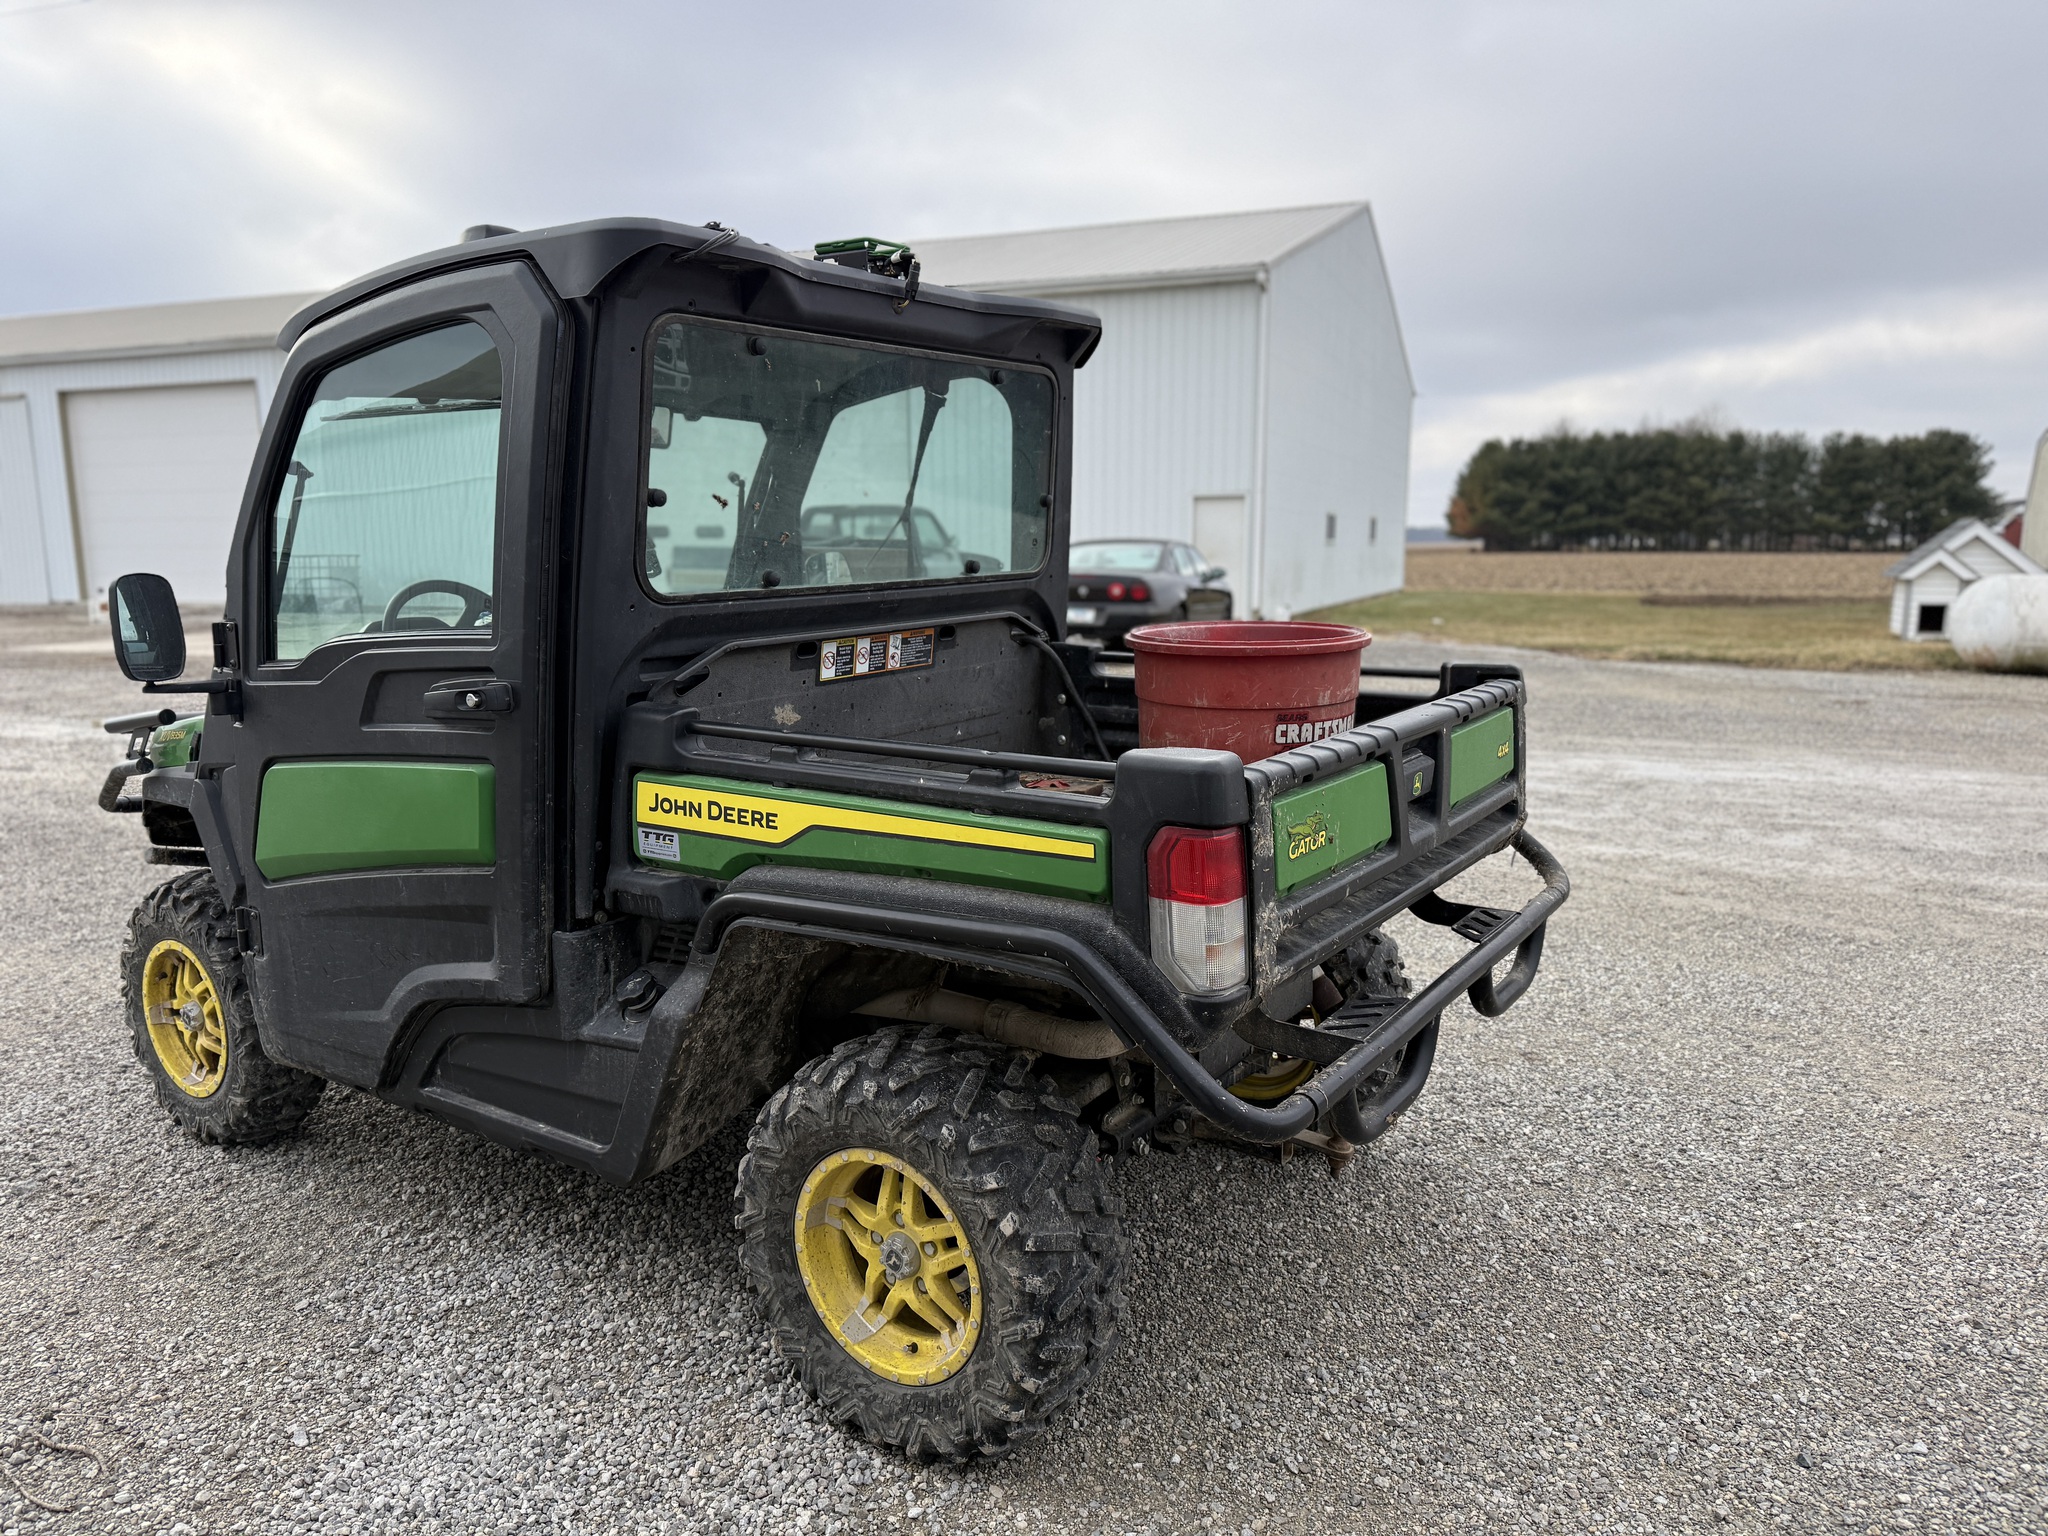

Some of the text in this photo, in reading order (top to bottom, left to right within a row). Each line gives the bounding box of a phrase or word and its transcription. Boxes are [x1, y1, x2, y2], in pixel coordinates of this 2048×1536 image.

[649, 793, 778, 830] JOHN DEERE
[641, 830, 674, 846] TTG
[643, 842, 673, 850] EQUIPMENT
[1289, 830, 1326, 860] GATOR
